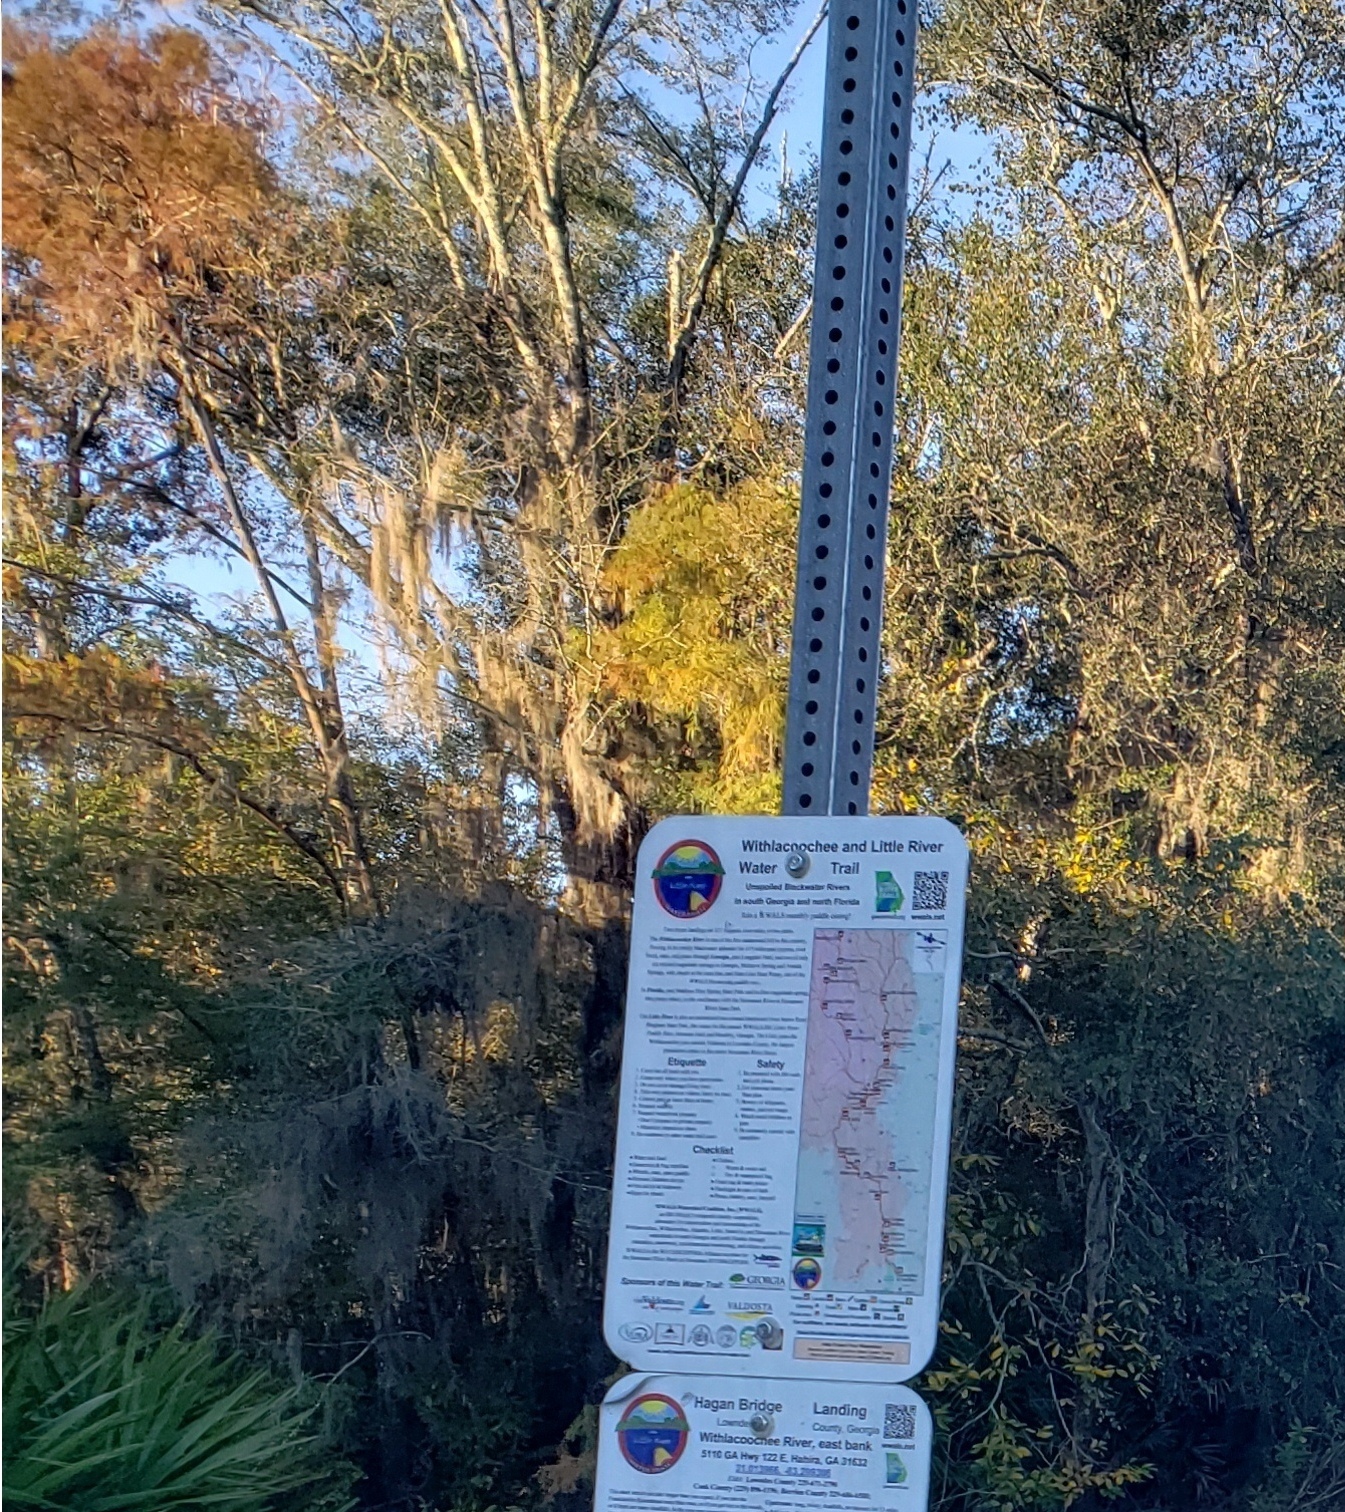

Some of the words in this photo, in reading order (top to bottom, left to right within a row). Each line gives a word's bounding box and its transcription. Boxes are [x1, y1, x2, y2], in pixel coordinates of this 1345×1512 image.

[742, 839, 839, 853] Withlacoochee
[842, 841, 866, 852] and
[871, 840, 904, 853] Little
[908, 841, 944, 853] River
[739, 861, 778, 874] Water
[831, 862, 859, 875] Trail
[766, 898, 795, 906] Georgia
[834, 898, 860, 906] Florida
[668, 1057, 707, 1068] Etiquette
[757, 1059, 785, 1071] Safety
[693, 1145, 734, 1155] Checklist
[620, 1277, 656, 1287] Sponsors
[658, 1278, 666, 1287] of
[667, 1279, 680, 1287] this
[682, 1280, 704, 1288] Water
[746, 1275, 785, 1285] GEORGIA
[727, 1301, 773, 1311] VALDOSTA
[694, 1396, 735, 1412] Hagan
[739, 1398, 783, 1413] Bridge
[813, 1402, 867, 1420] Landing
[847, 1424, 880, 1437] Georgia
[699, 1431, 781, 1447] Withlacoochee
[783, 1436, 816, 1450] River,
[818, 1439, 842, 1449] east
[845, 1439, 873, 1451] bank
[724, 1451, 738, 1459] GA
[740, 1452, 759, 1463] Hwy
[762, 1453, 778, 1462] 122
[825, 1456, 840, 1466] GA
